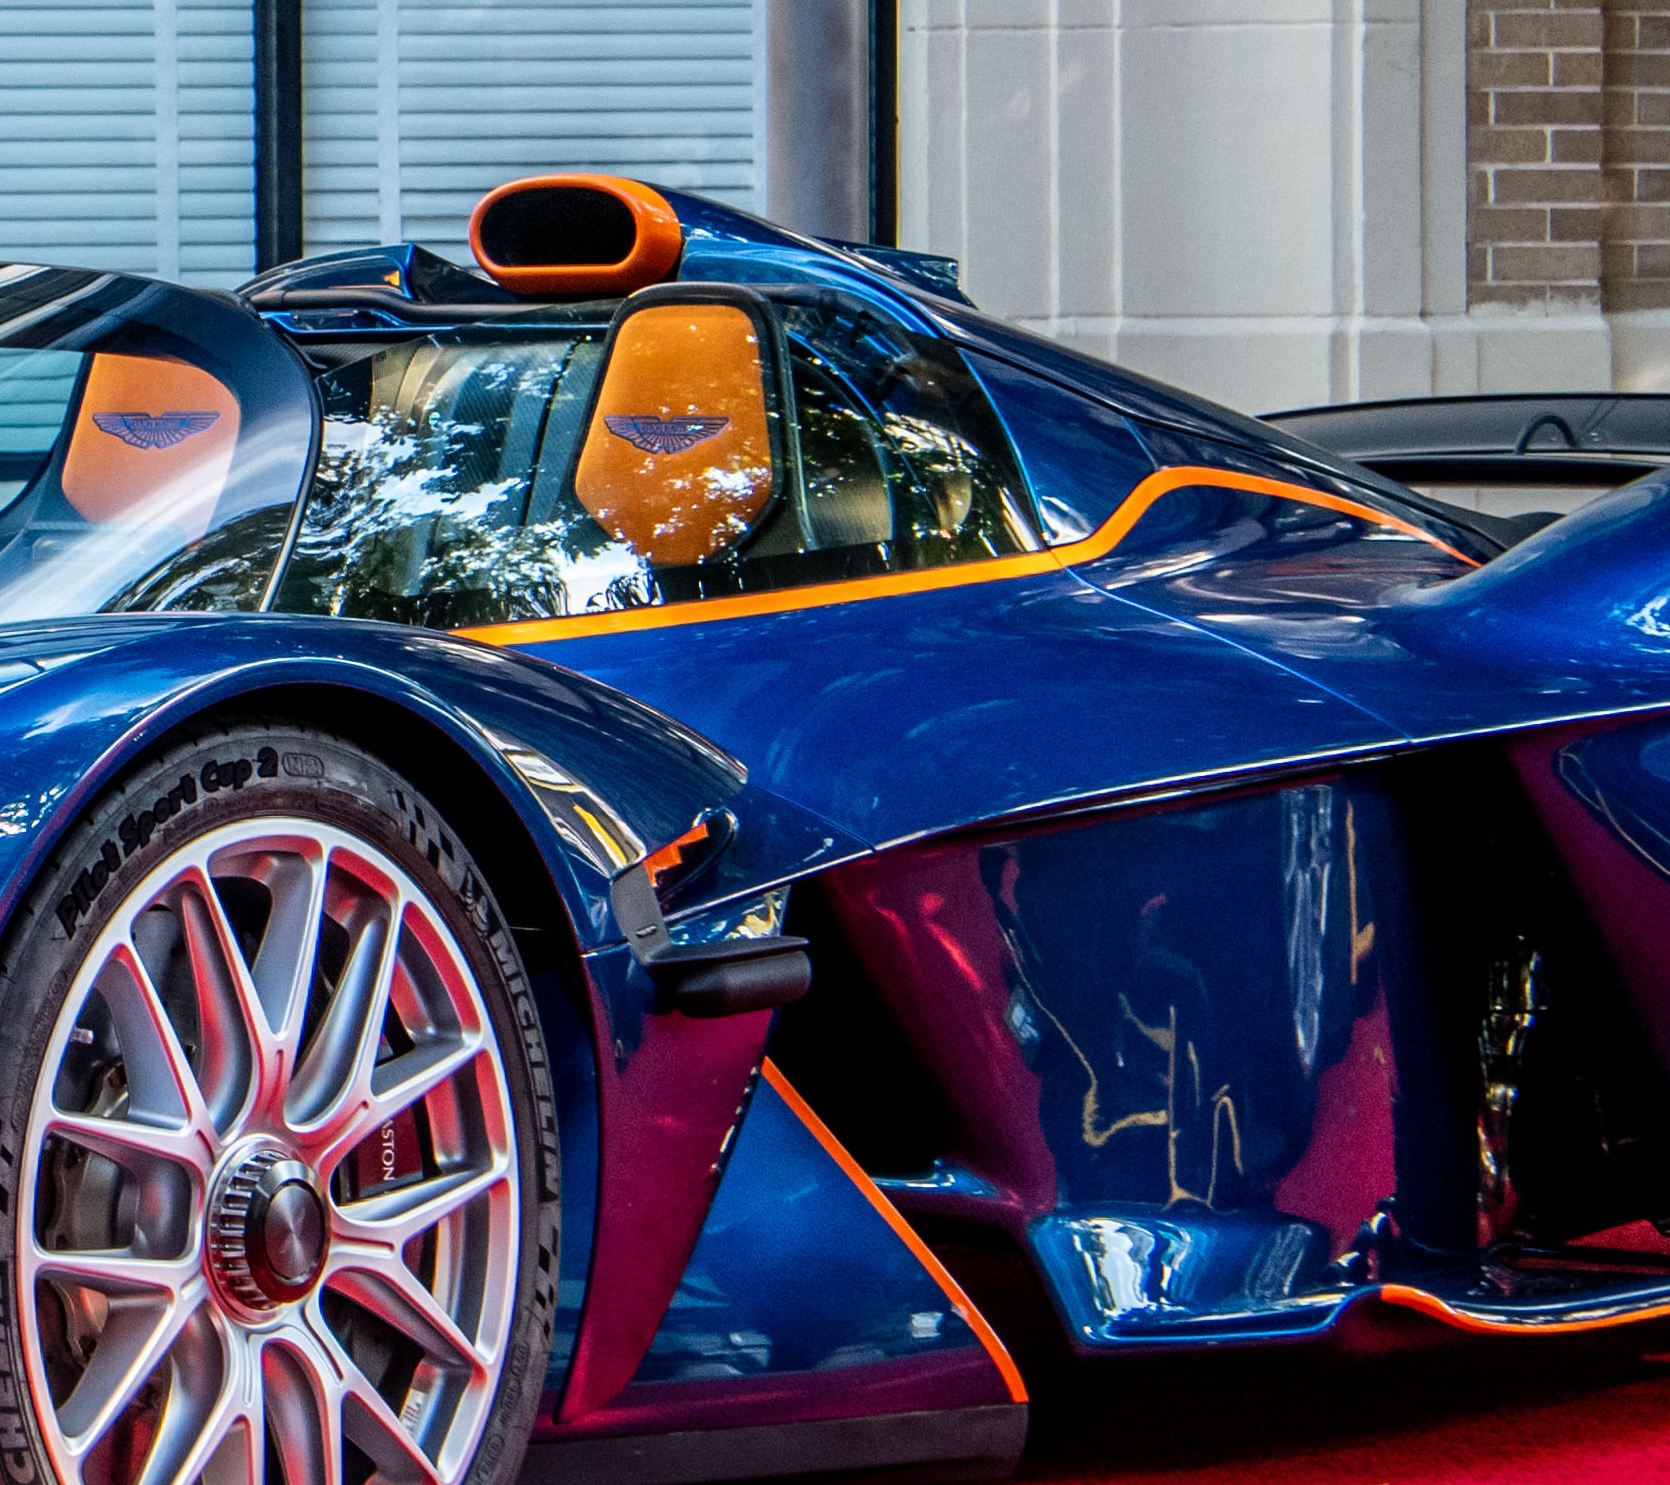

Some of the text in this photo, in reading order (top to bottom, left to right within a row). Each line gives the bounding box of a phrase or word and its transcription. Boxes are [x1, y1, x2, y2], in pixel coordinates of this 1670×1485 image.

[55, 746, 279, 941] Pilot Sport Cup 2
[489, 927, 558, 1196] MICHELIN
